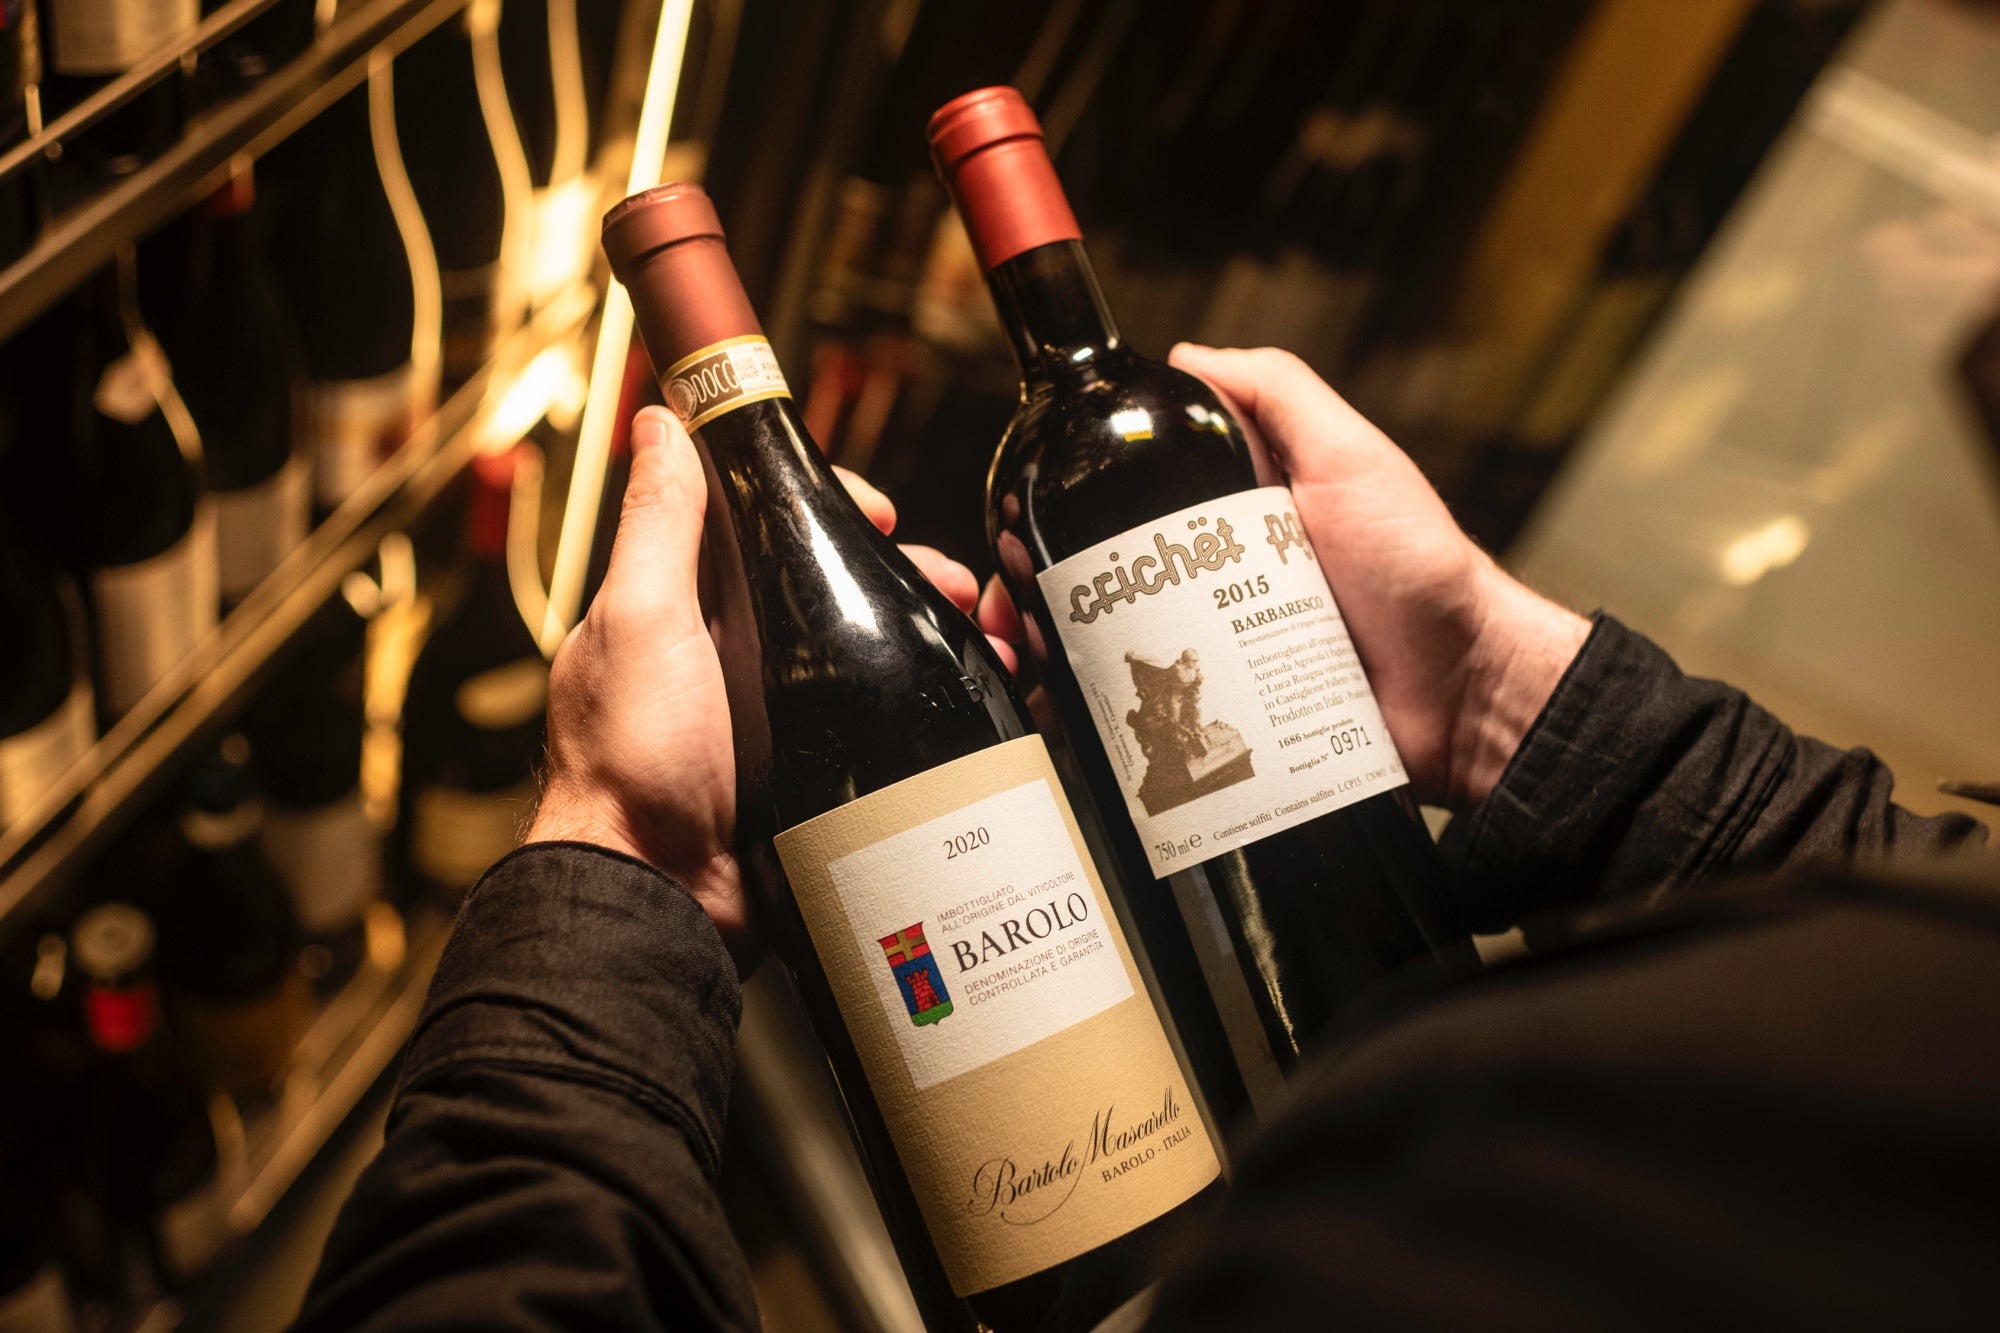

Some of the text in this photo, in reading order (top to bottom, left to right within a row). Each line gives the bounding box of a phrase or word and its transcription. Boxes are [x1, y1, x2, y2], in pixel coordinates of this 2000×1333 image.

[1070, 517, 1245, 624] crichët
[1213, 574, 1270, 610] 2015
[1230, 596, 1324, 634] BARBARESCO
[1247, 647, 1307, 669] Imbottigliato
[1254, 662, 1292, 683] Azienda
[1266, 679, 1291, 694] Luca
[1275, 682, 1324, 706] Castiglione
[1269, 706, 1314, 728] Prodotto
[1278, 733, 1302, 749] 1686
[1289, 757, 1321, 774] Bottiglia
[1330, 725, 1371, 755] 0971
[943, 827, 991, 860] 2020
[1155, 840, 1177, 862] 750
[1177, 839, 1190, 856] ml
[1213, 822, 1248, 841] Contiene
[1248, 812, 1273, 828] solfiti
[1274, 798, 1309, 817] Contains
[1309, 787, 1336, 804] sulfites
[936, 885, 1015, 923] IMBOTTIGLIATO
[942, 872, 1075, 934] ALL'ORIGINE DAL VITICOLTORE
[950, 893, 1088, 973] BAROLO
[964, 929, 1100, 995] DENOMINAZIONE DI ORIGINE
[969, 965, 1049, 1006] CONTROLLATA
[1050, 960, 1058, 971] E
[1101, 1148, 1155, 1183] BAROLO
[1162, 1126, 1192, 1151] ITALIA
[968, 1139, 1080, 1216] Bartolo
